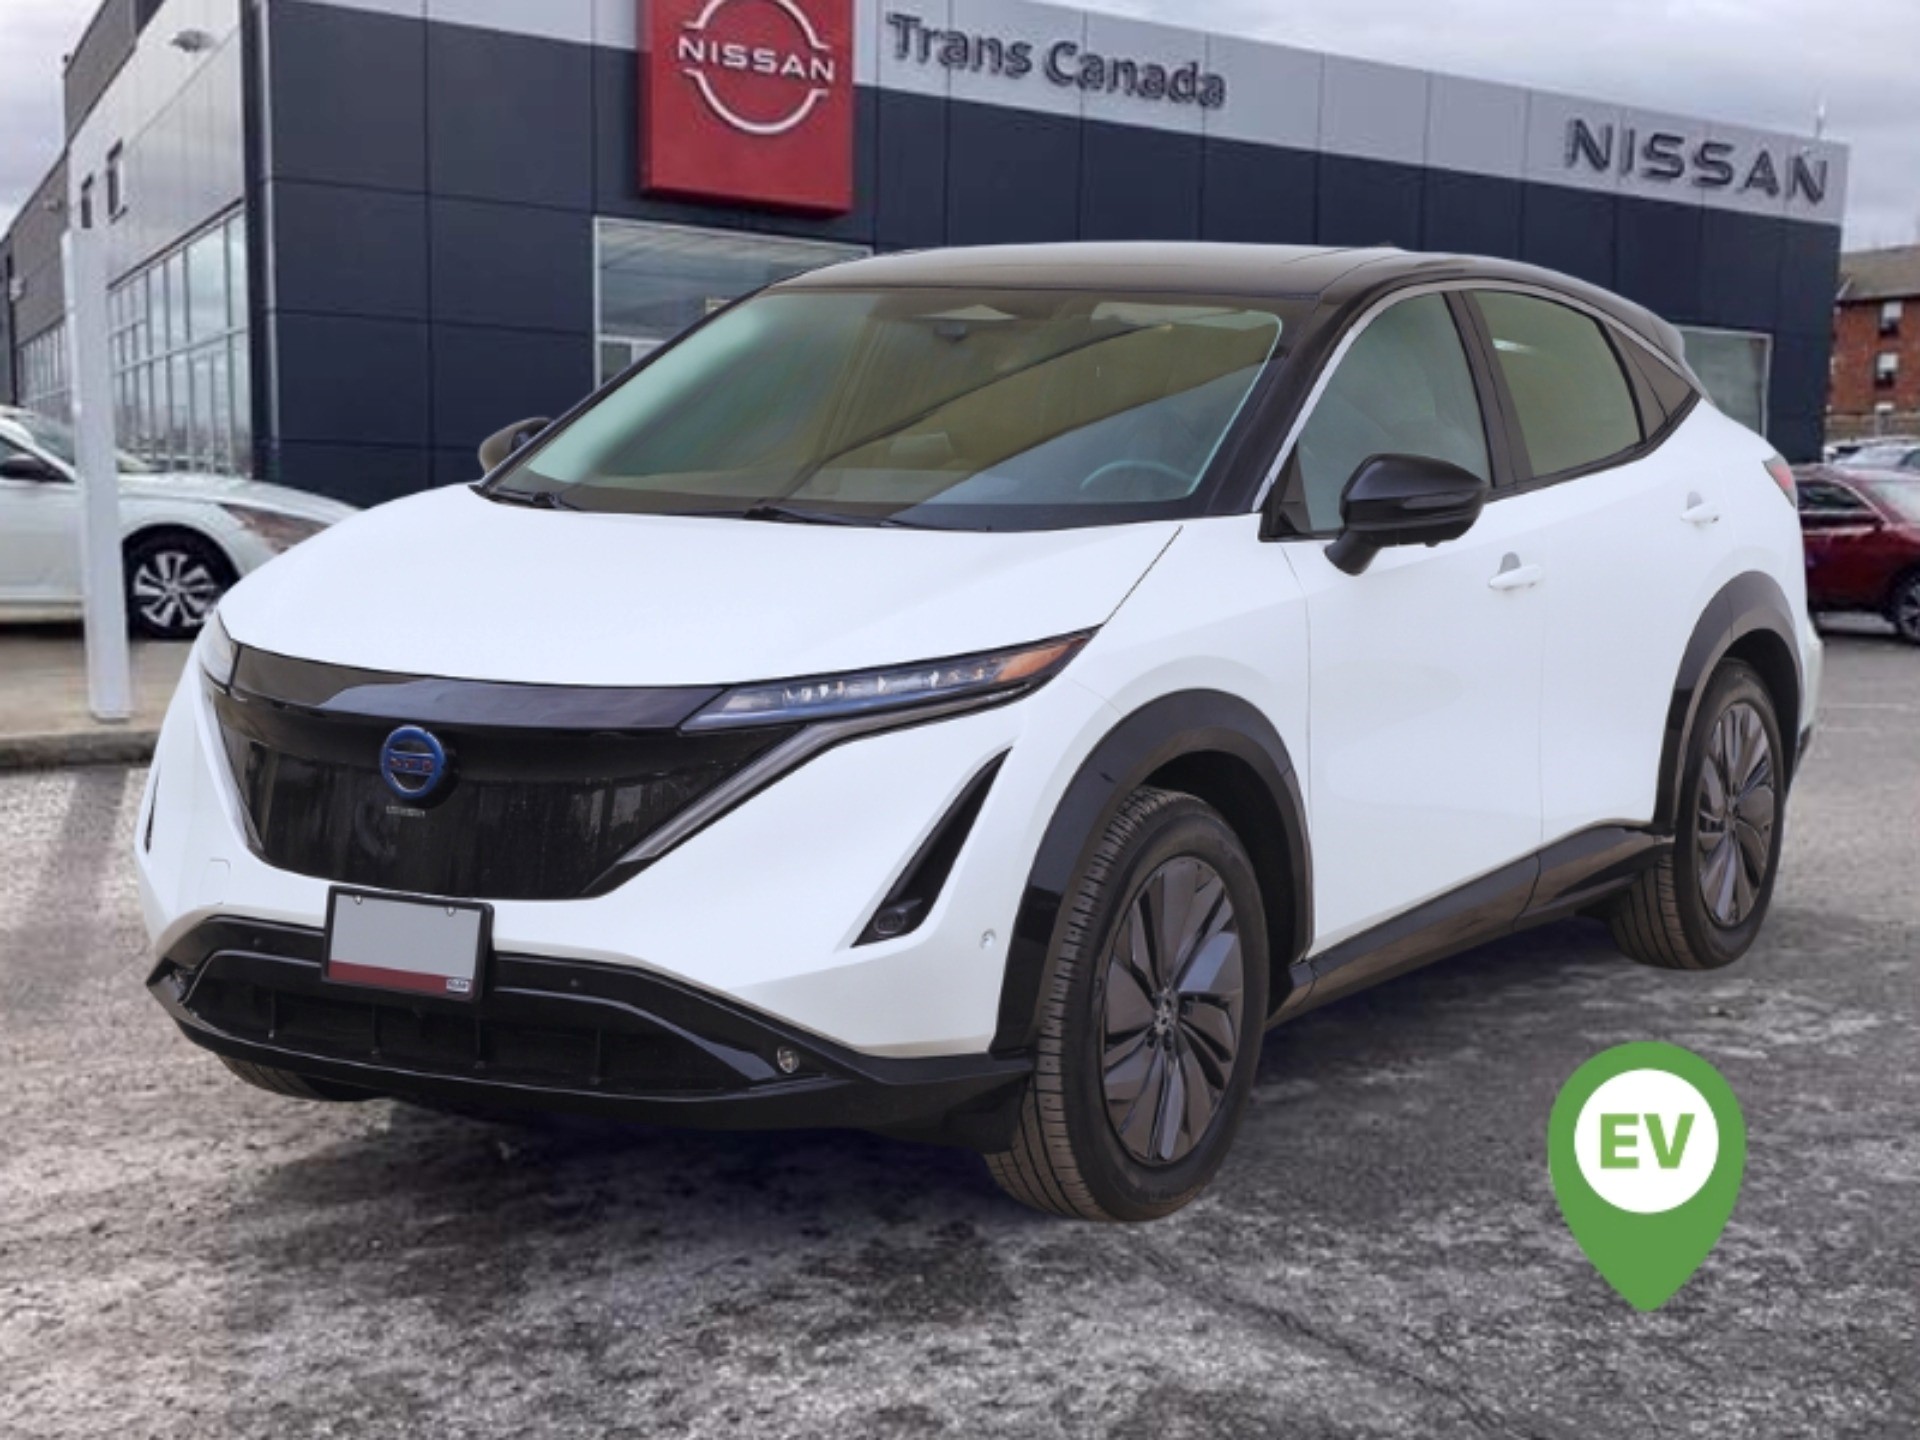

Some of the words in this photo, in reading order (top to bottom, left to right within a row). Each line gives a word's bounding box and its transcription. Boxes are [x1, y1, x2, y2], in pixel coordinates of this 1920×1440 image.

[678, 35, 835, 82] NISSAN
[886, 12, 1033, 79] Trans
[1043, 41, 1226, 108] Canada
[1564, 118, 1828, 205] NISSAN
